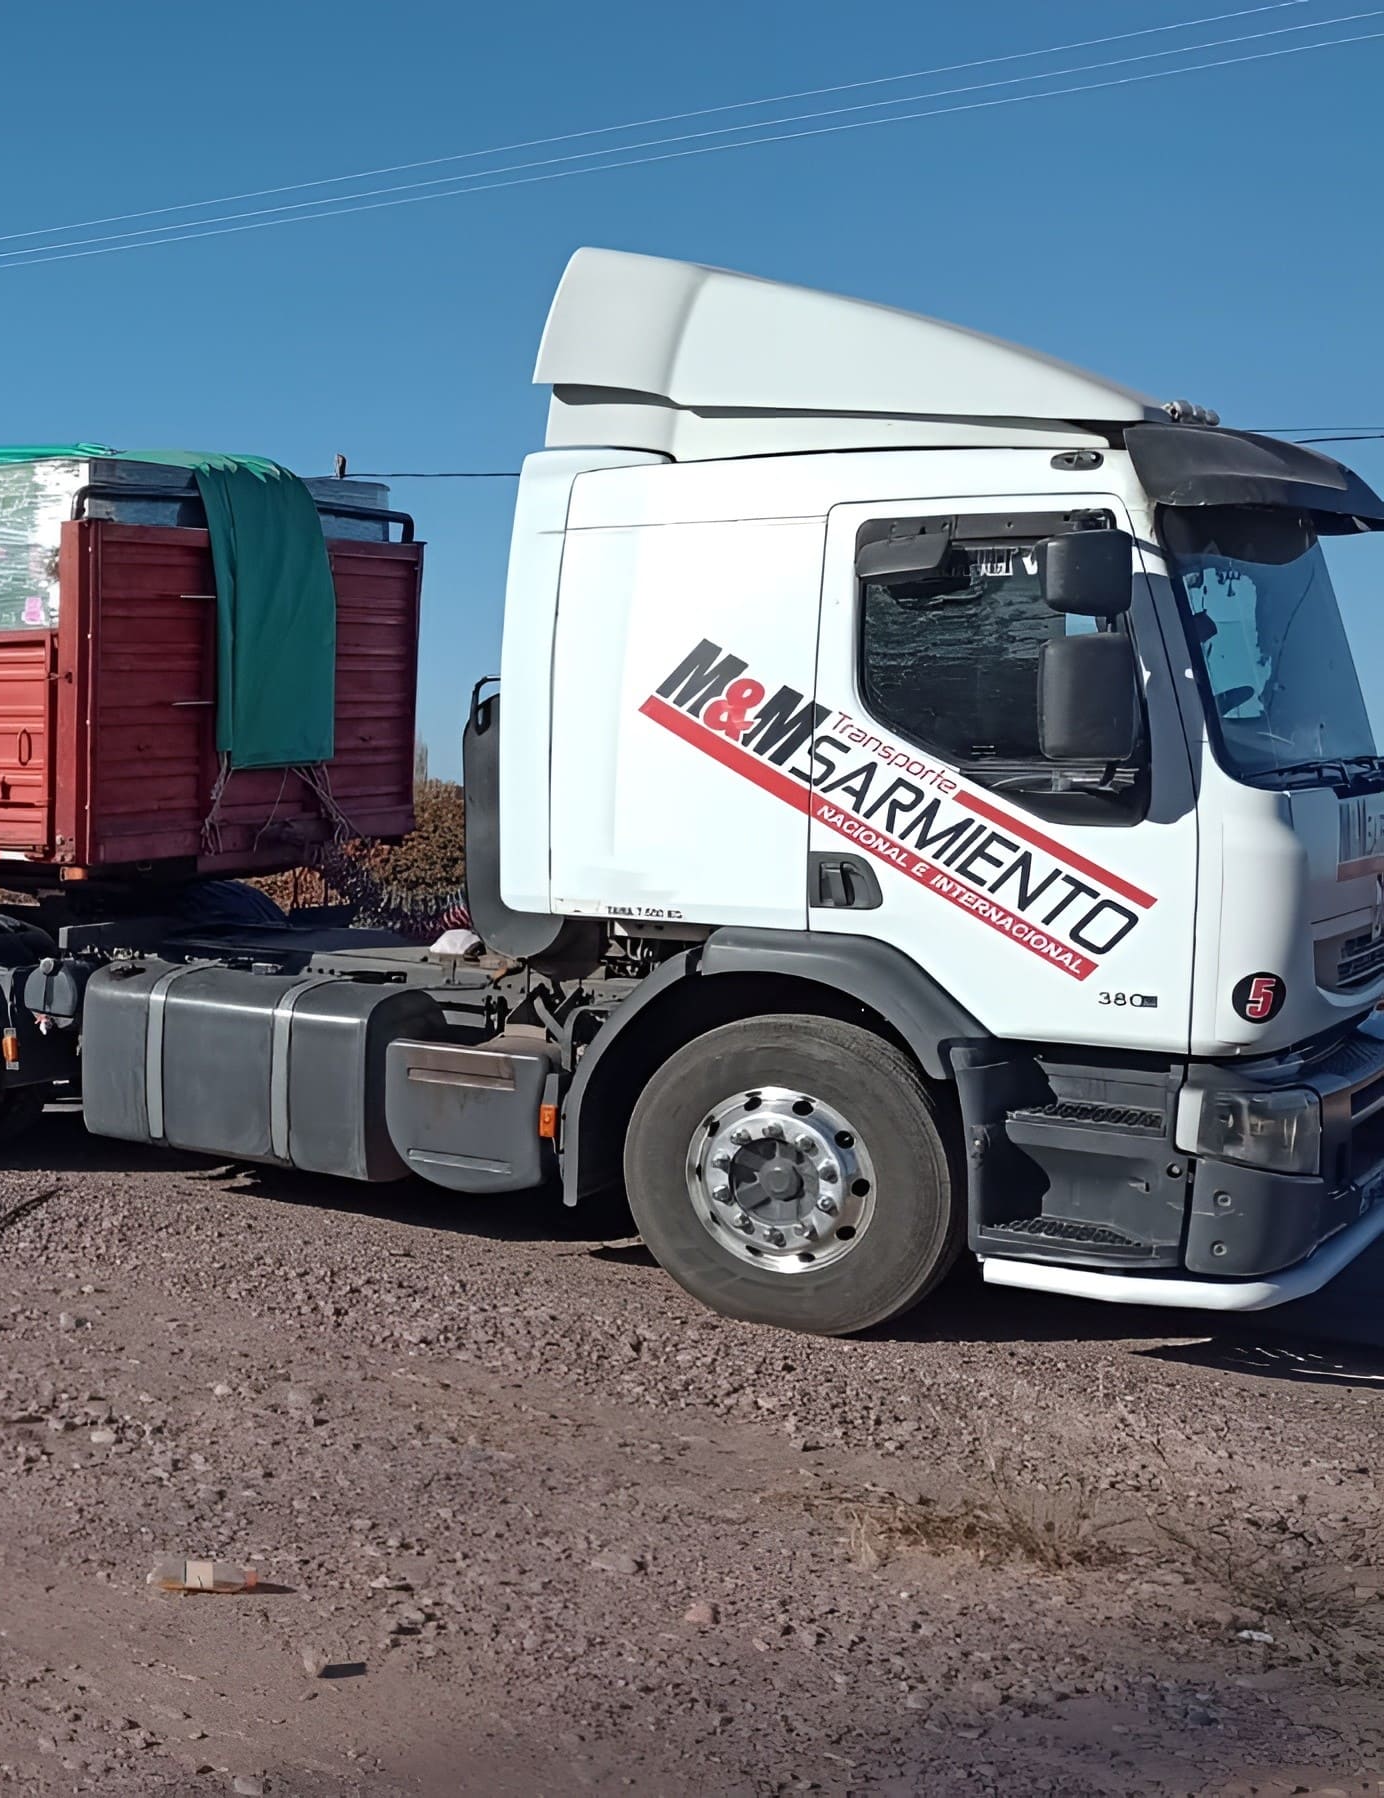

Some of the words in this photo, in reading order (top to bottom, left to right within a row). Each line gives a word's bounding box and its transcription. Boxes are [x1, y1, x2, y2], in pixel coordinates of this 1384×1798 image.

[655, 637, 833, 767] M&M
[830, 710, 959, 795] Transporte
[787, 734, 1140, 956] SARMIENTO
[816, 804, 908, 867] NACIONAL
[911, 863, 927, 879] E
[929, 874, 1082, 975] INTERNACIONAL
[1097, 991, 1145, 1009] 380
[1245, 977, 1277, 1020] 5
